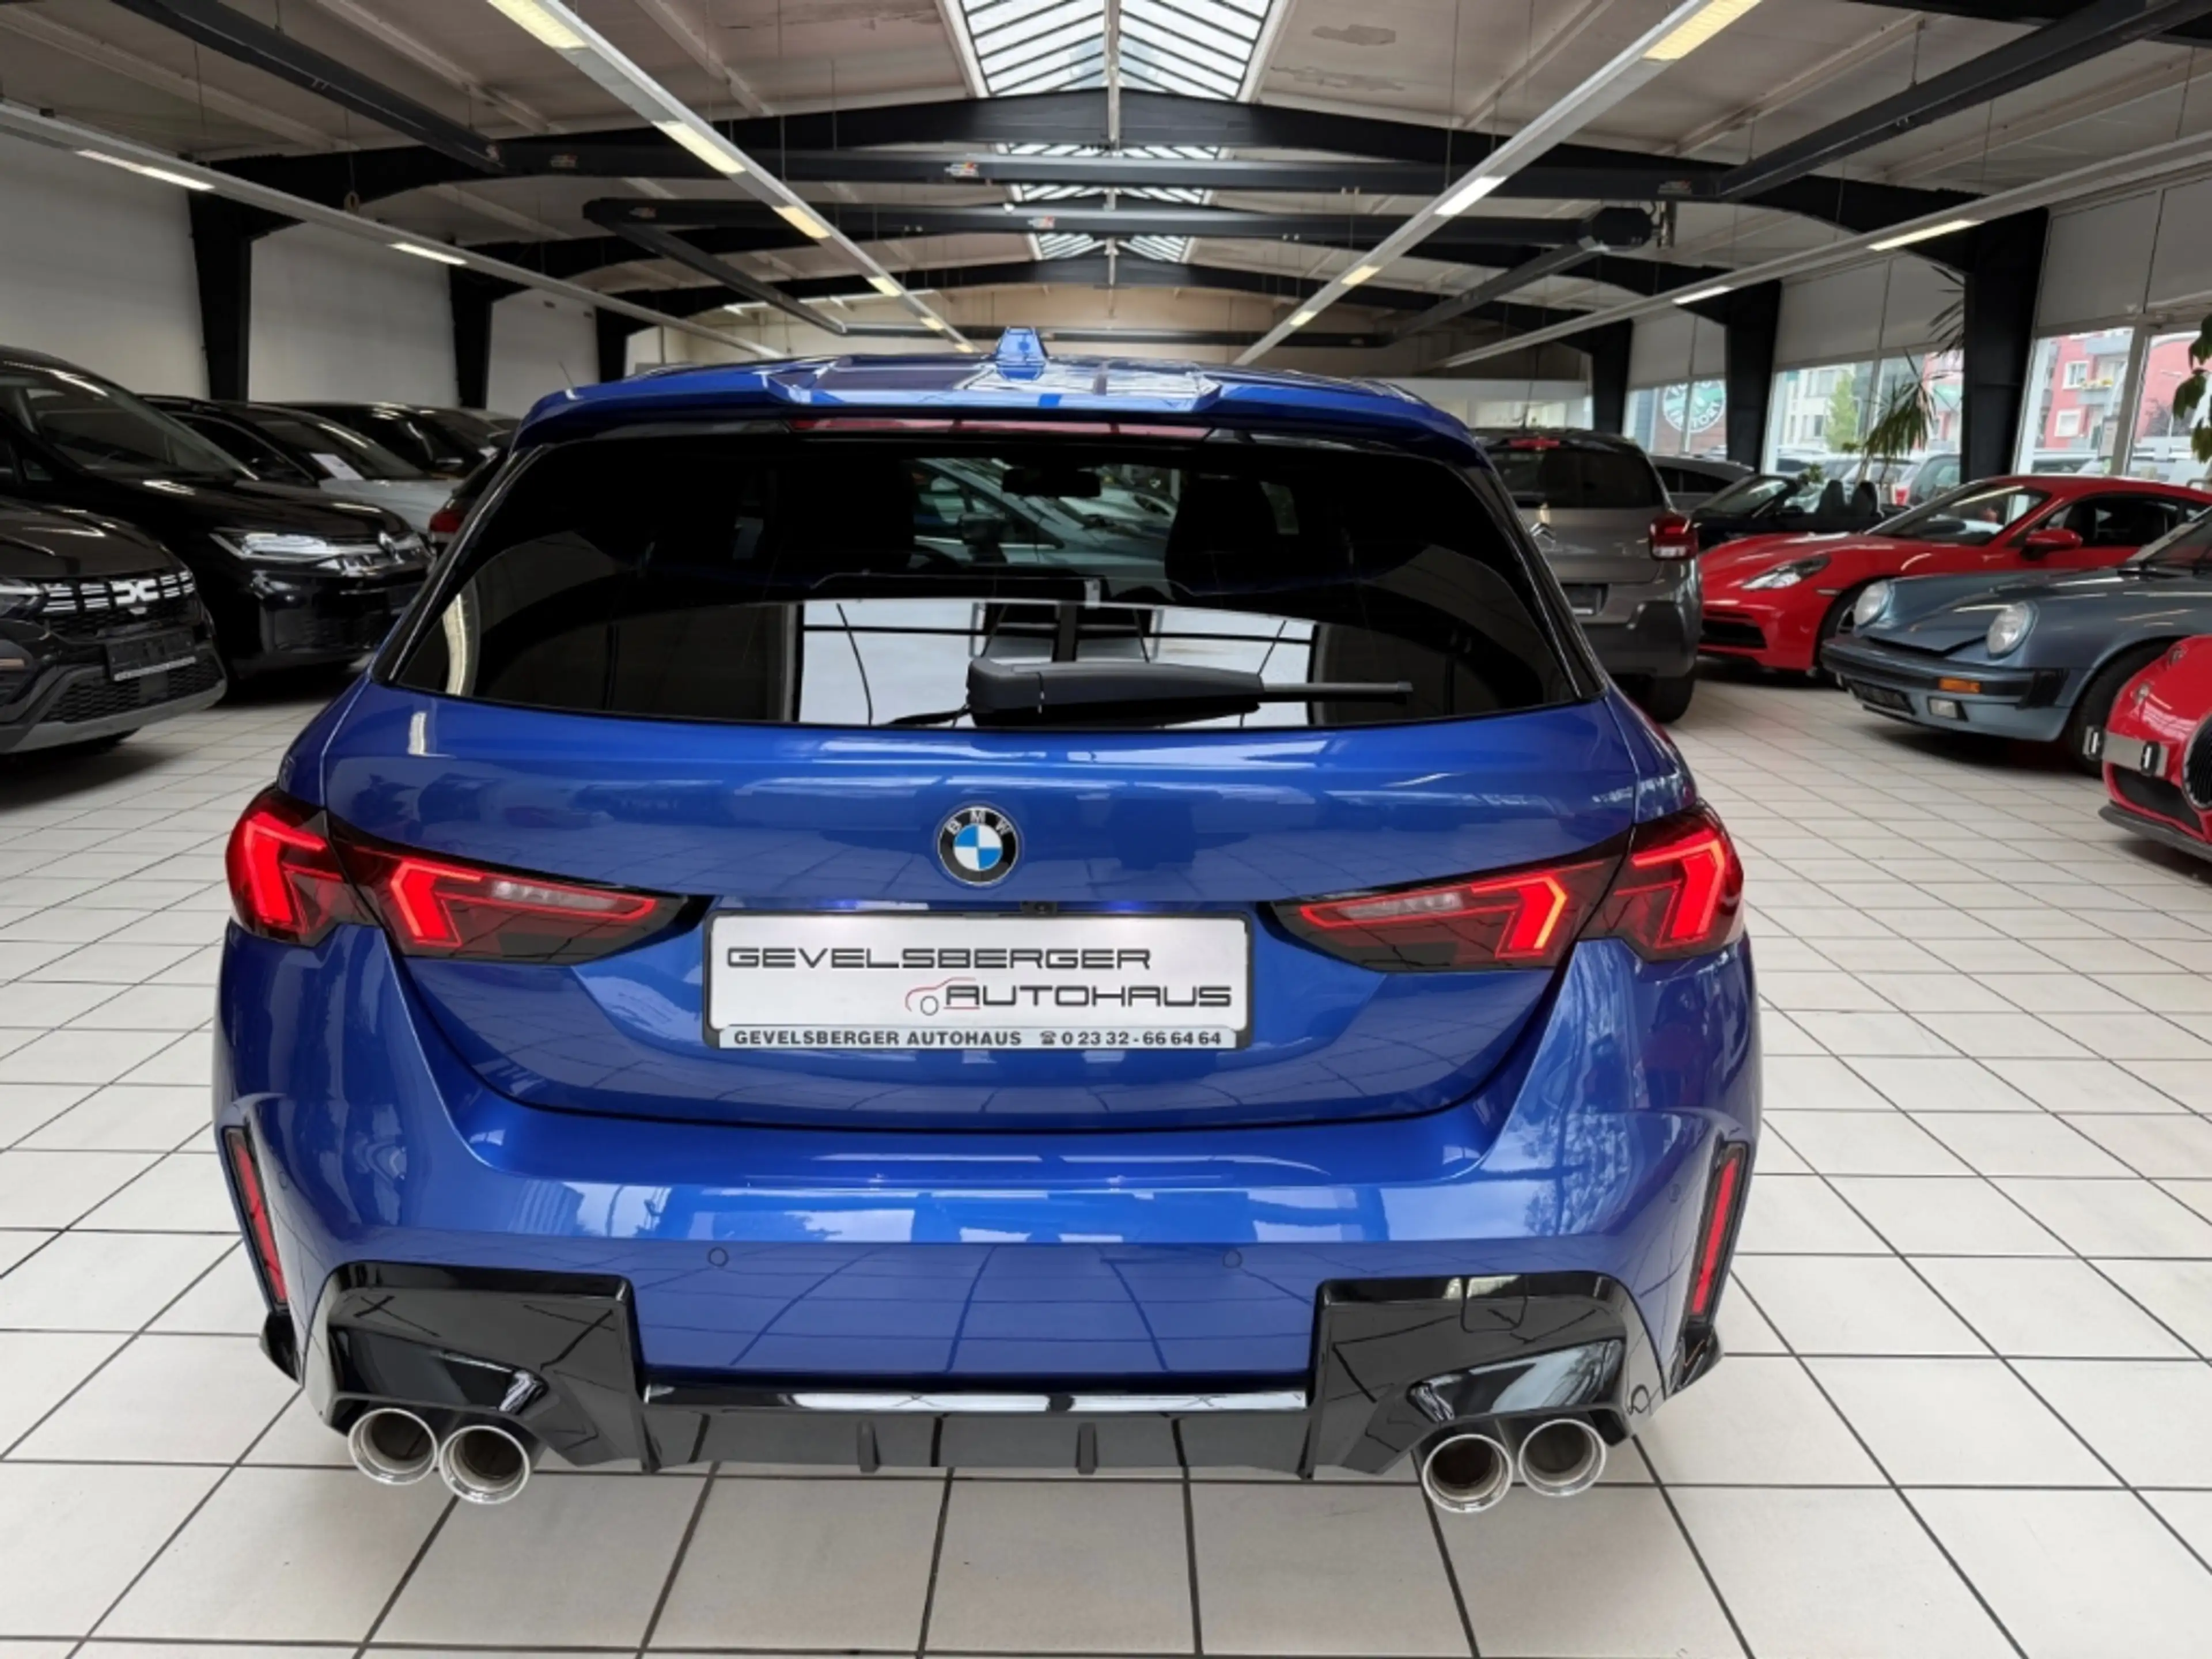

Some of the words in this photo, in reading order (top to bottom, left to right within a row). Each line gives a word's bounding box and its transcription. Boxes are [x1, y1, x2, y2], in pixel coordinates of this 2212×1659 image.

[727, 948, 1151, 969] GEVELSBERGER
[946, 985, 1232, 1007] AUTOHAUS
[733, 1031, 900, 1045] GEVELSBERGER
[907, 1031, 1022, 1046] AUTOHAUS
